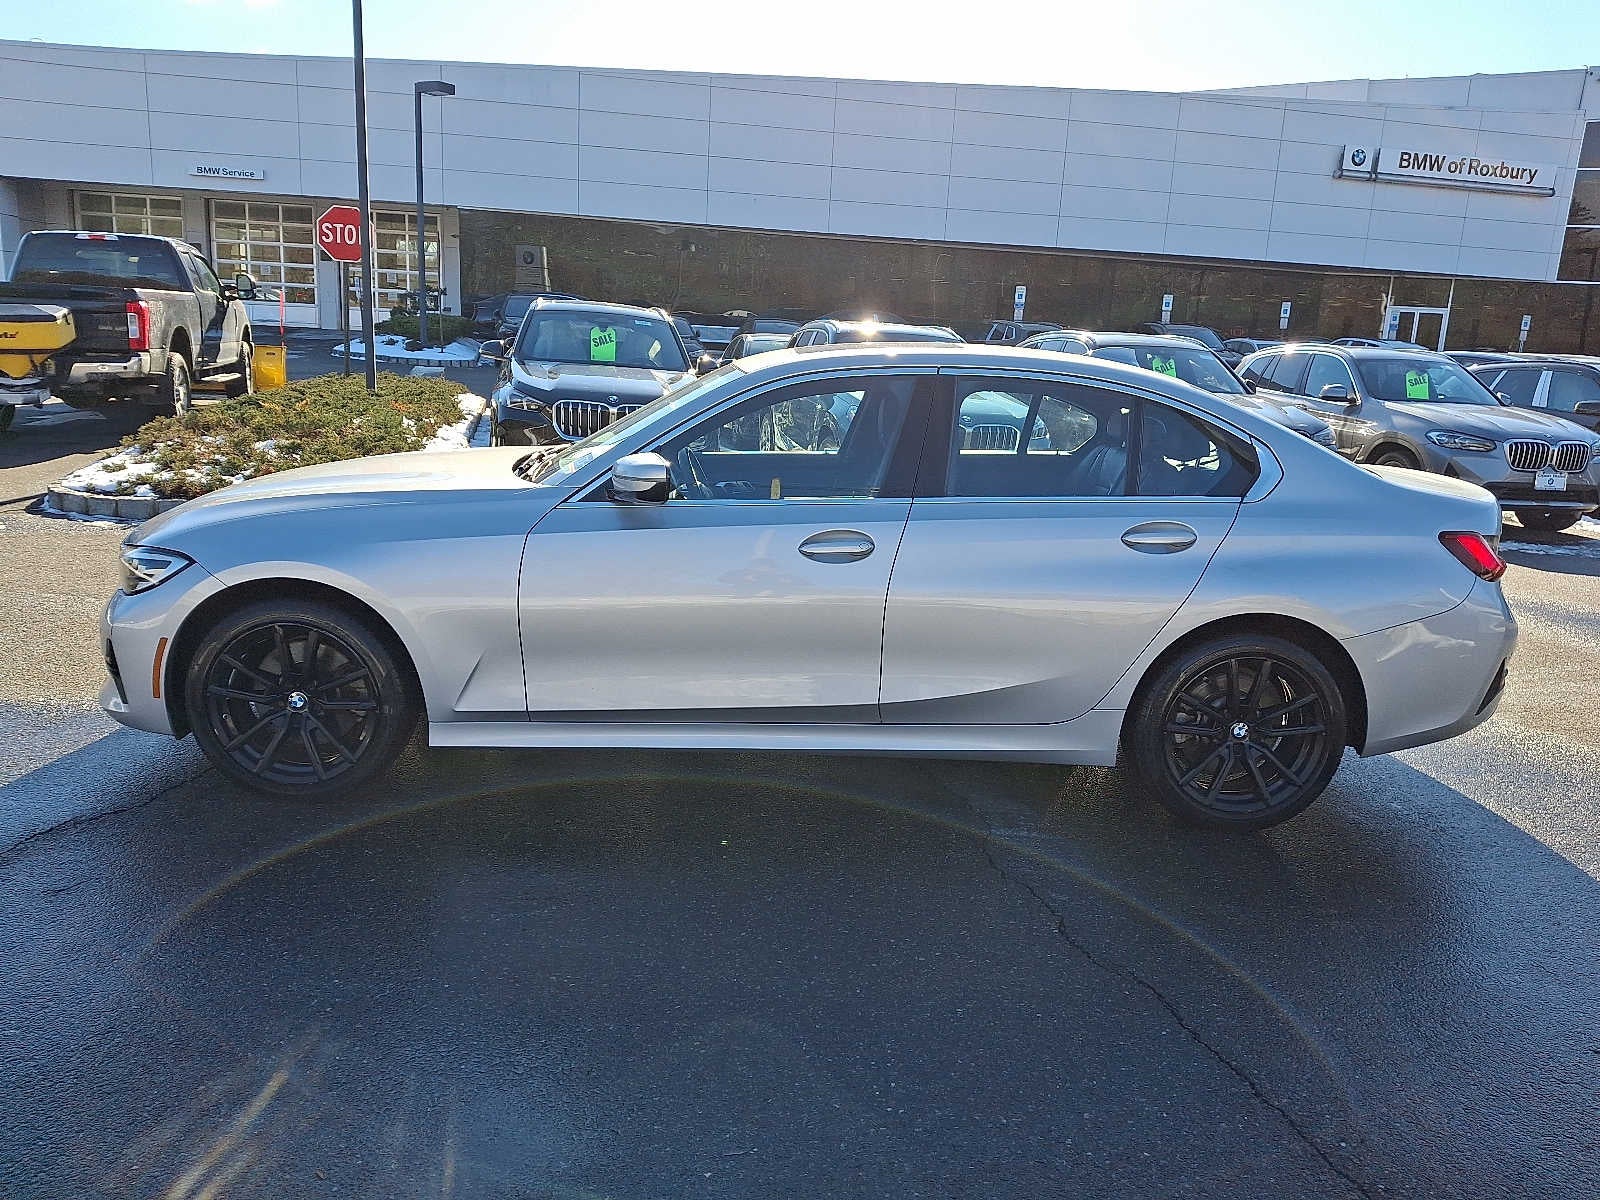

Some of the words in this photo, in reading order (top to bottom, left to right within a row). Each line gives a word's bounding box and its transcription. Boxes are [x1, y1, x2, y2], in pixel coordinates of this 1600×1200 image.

[196, 166, 221, 175] BMW
[221, 167, 255, 178] Service
[1399, 151, 1446, 172] BMW
[1447, 157, 1466, 174] of
[1467, 158, 1538, 185] Roxbury
[321, 222, 361, 245] STO
[592, 333, 615, 348] SALE
[1408, 376, 1428, 387] SALE
